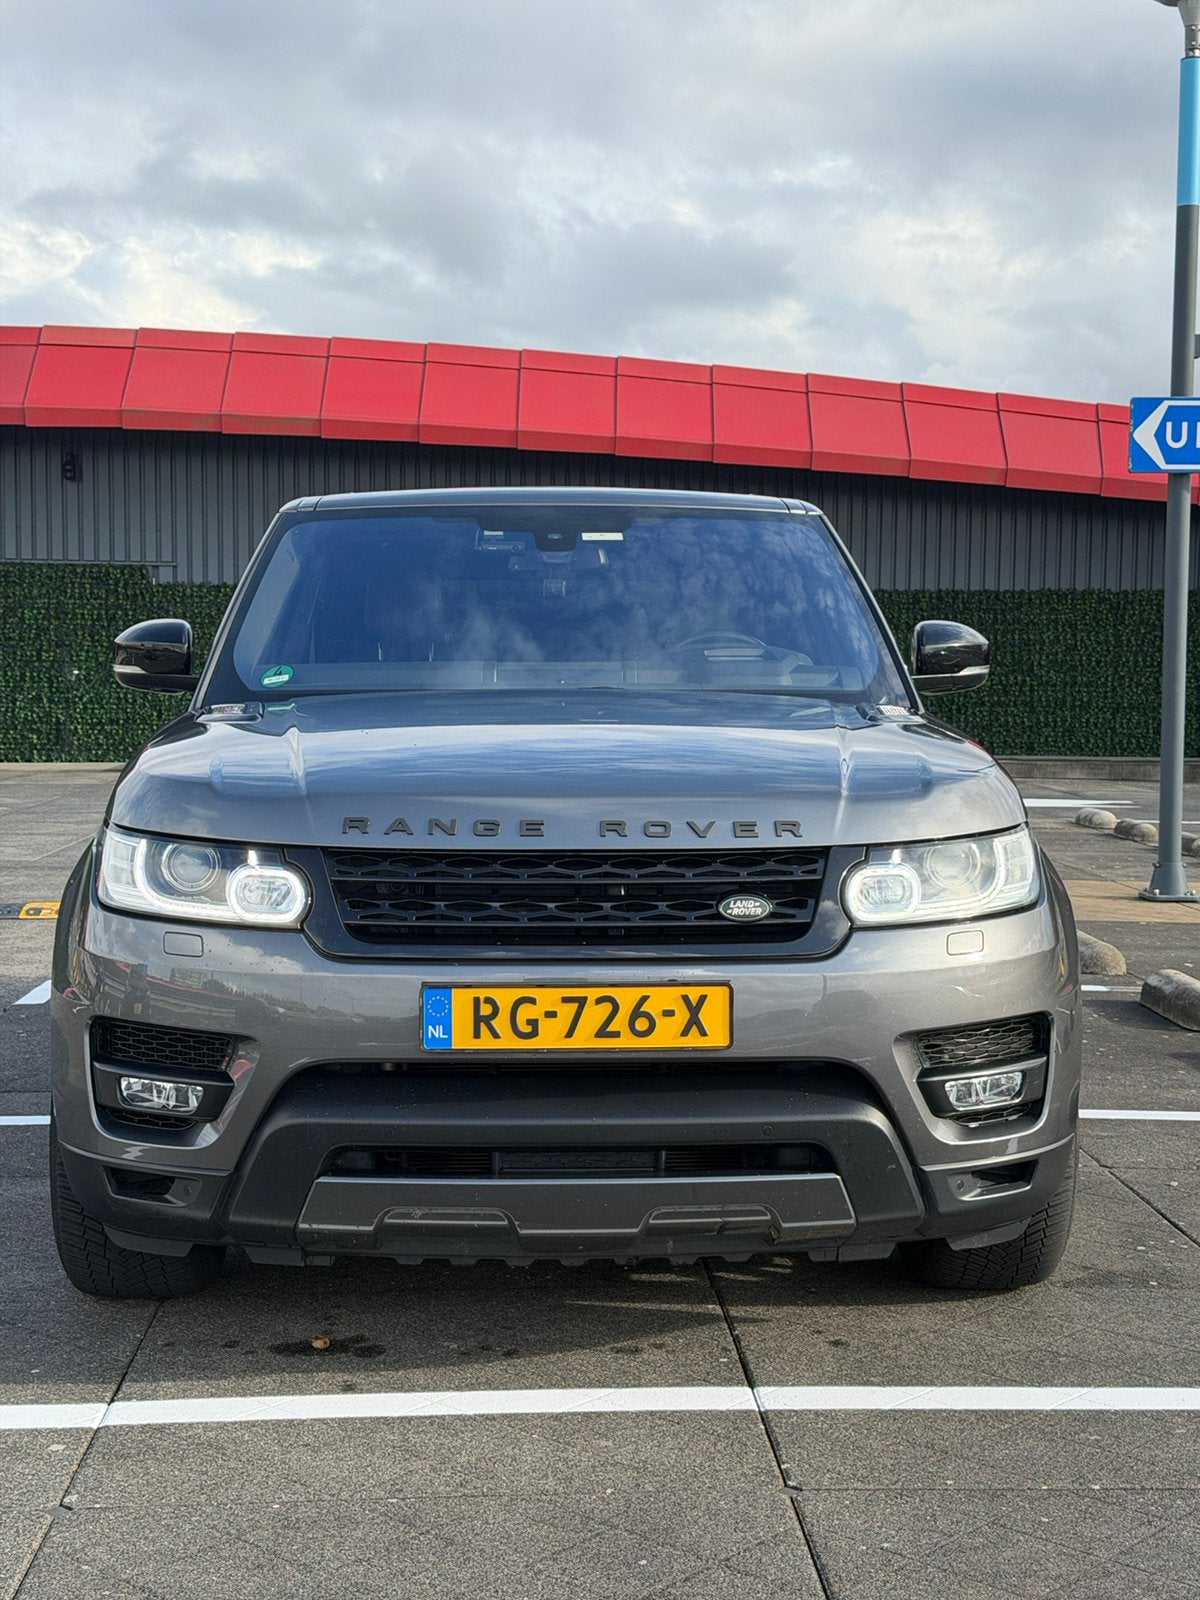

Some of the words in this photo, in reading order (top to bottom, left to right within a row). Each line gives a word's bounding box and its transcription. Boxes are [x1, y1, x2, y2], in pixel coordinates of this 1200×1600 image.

[341, 816, 545, 837] RANGE
[599, 819, 803, 838] ROVER
[730, 900, 755, 908] LAND
[731, 907, 762, 916] ROVER
[472, 993, 709, 1040] RG-726-X
[428, 1024, 449, 1039] NL
